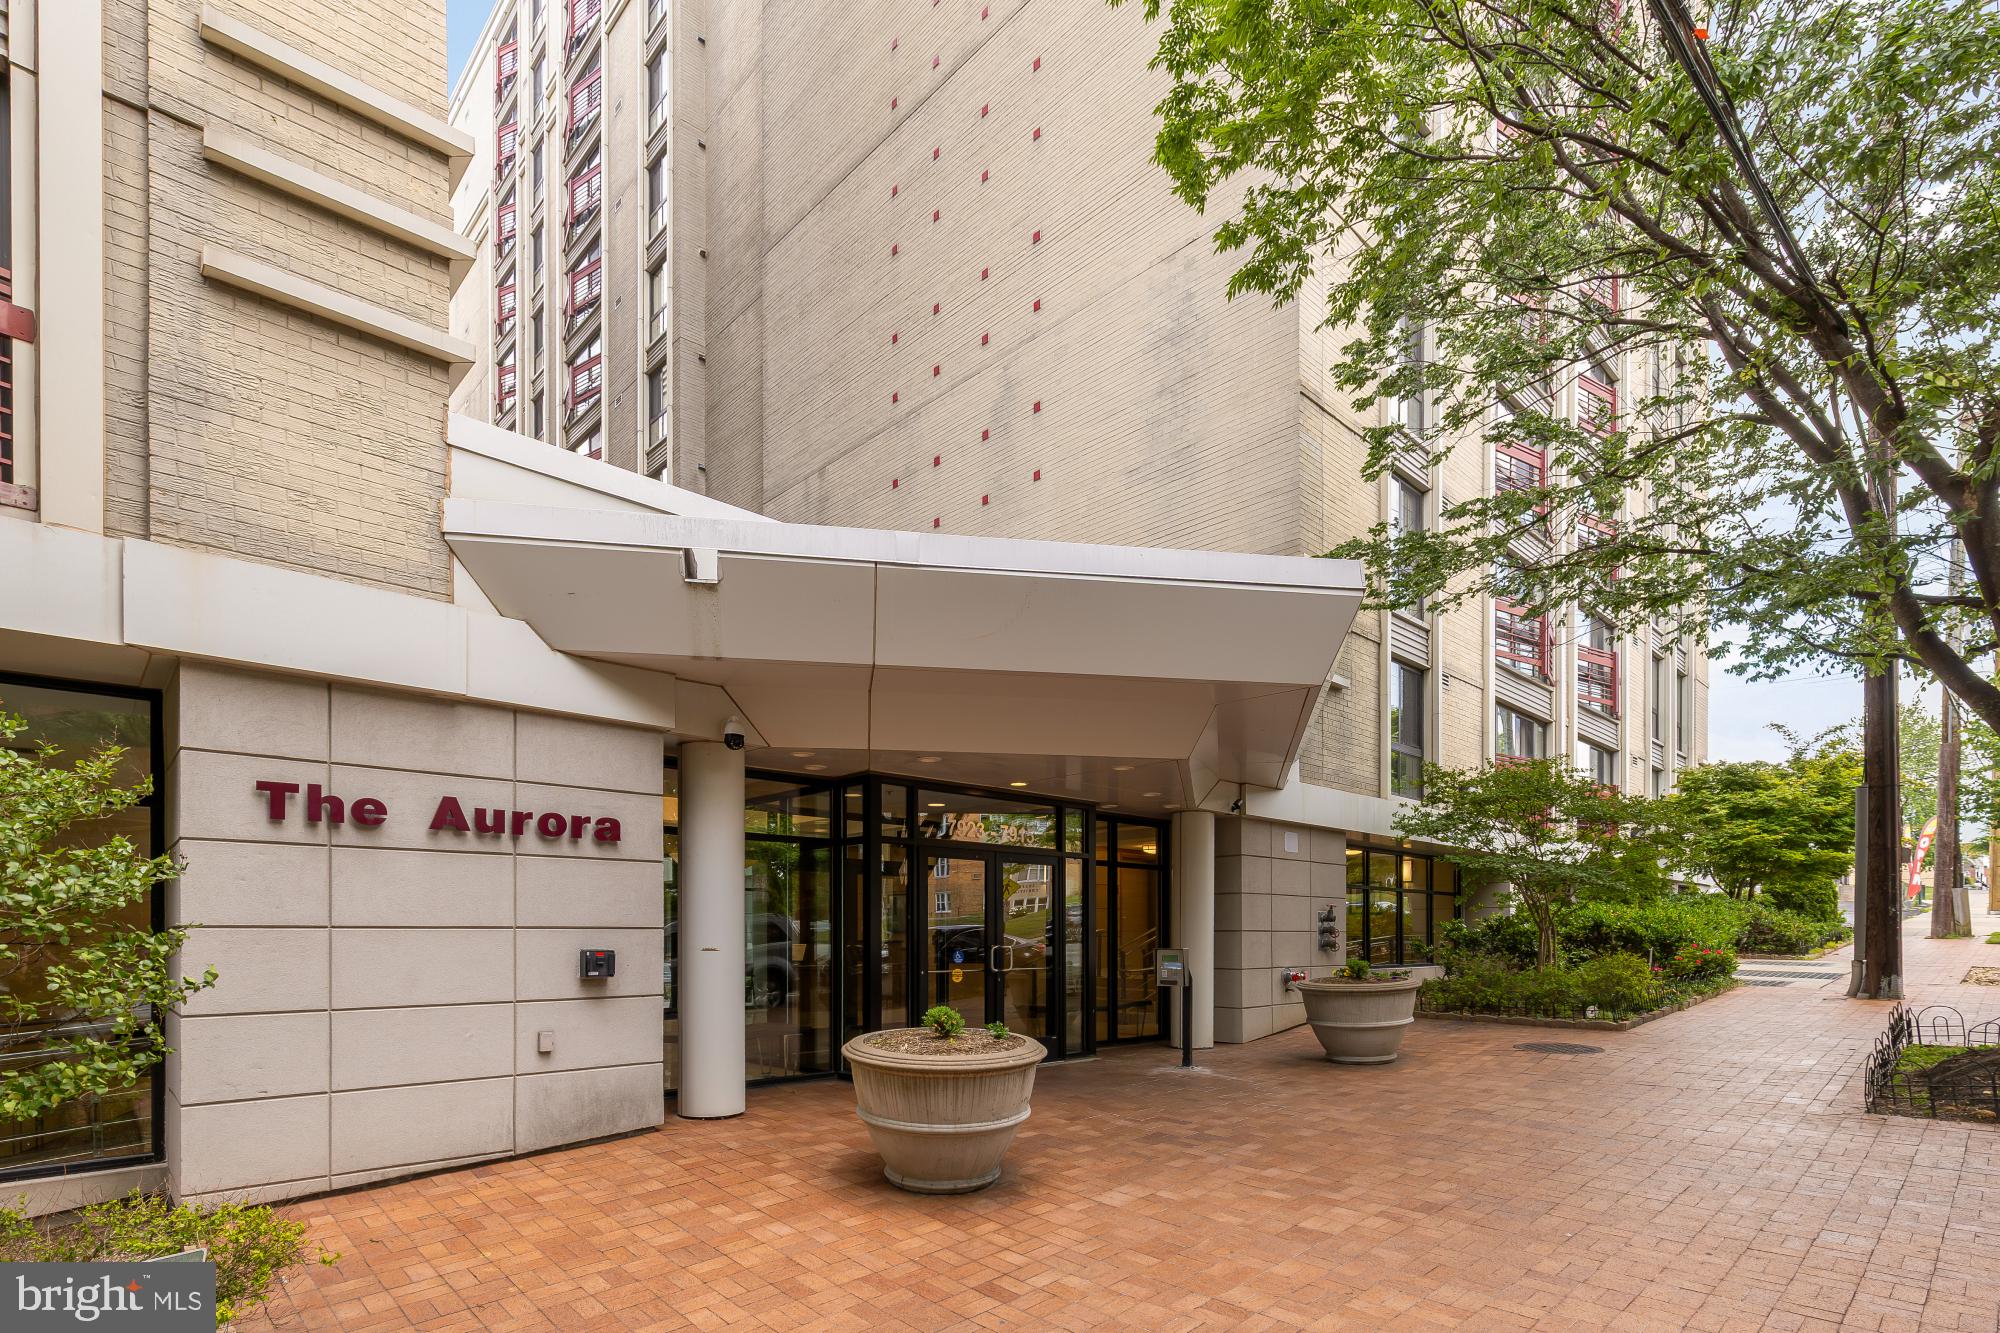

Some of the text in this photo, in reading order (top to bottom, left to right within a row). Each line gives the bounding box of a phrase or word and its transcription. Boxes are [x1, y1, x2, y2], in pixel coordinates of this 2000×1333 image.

[256, 780, 622, 842] The Aurora
[947, 819, 985, 839] 7923
